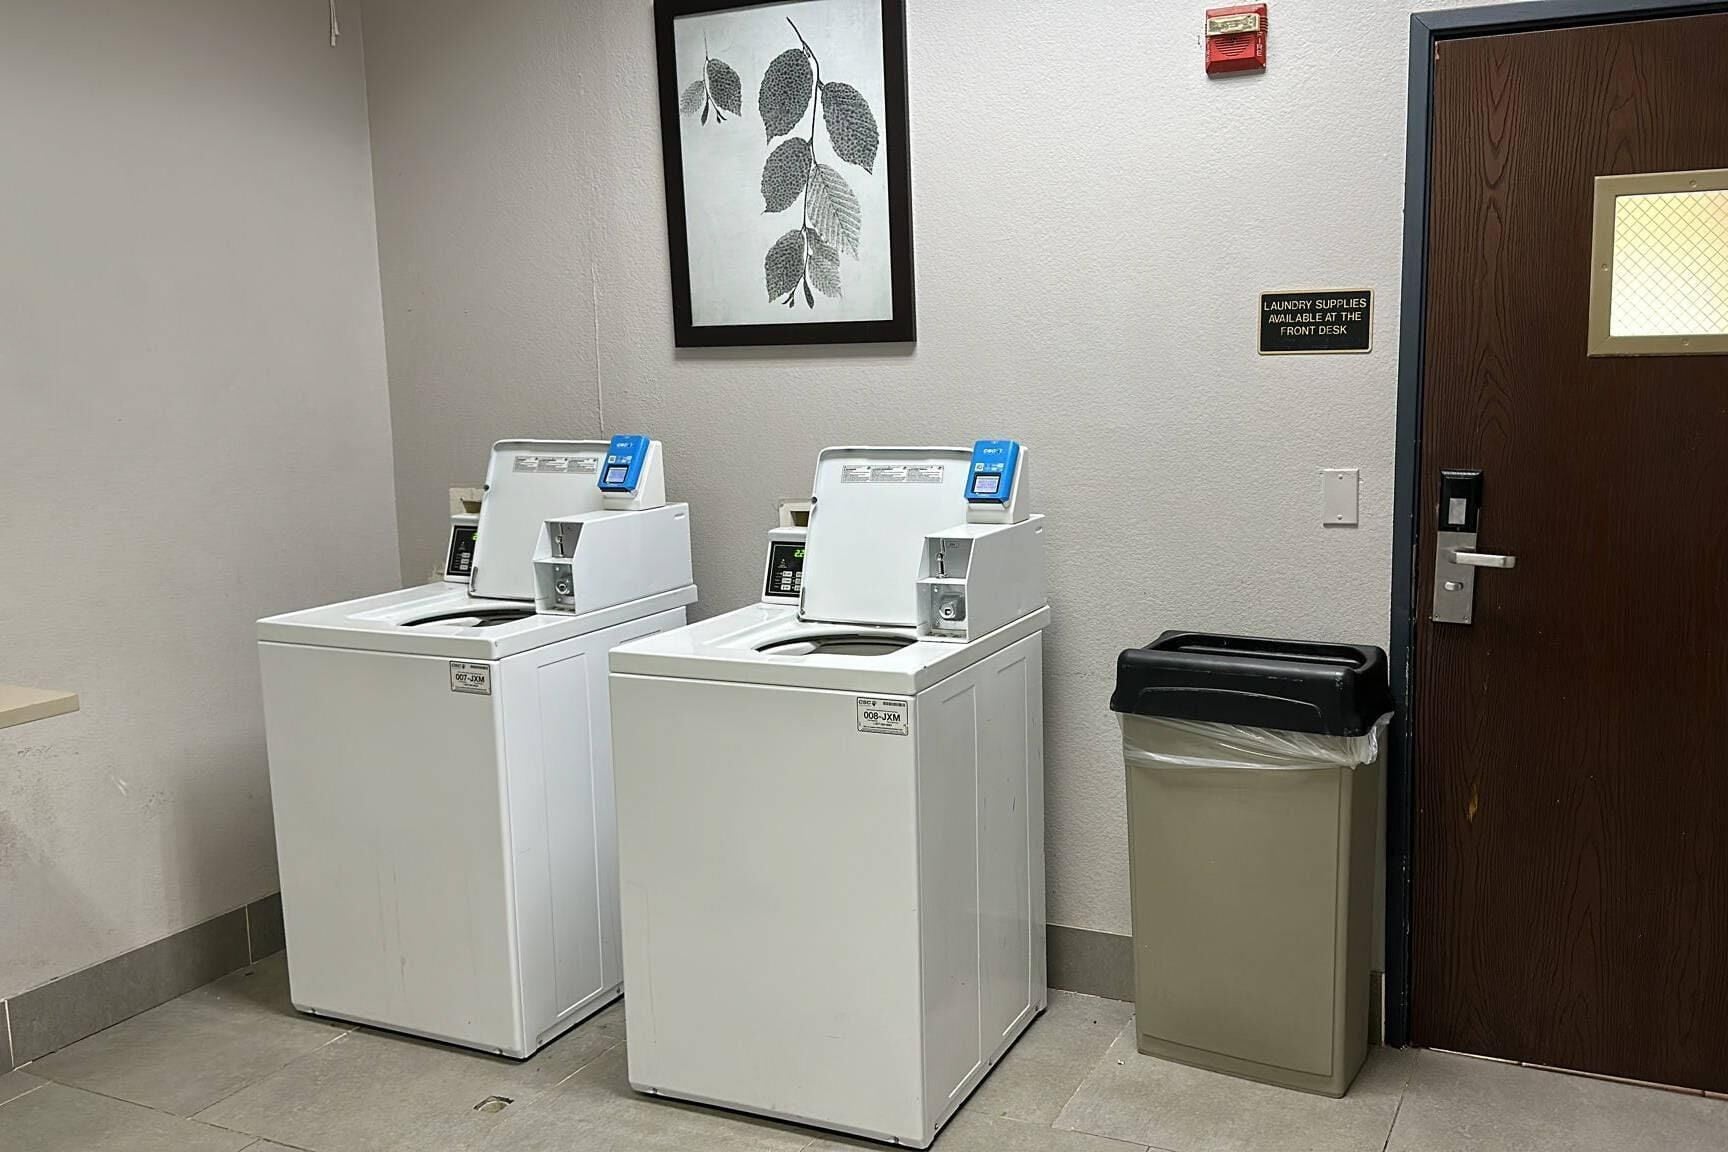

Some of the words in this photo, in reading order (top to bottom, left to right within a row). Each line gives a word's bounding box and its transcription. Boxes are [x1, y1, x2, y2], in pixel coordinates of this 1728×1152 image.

[1263, 300, 1312, 311] LAUNDRY
[1315, 298, 1367, 310] SUPPLIES
[1268, 312, 1322, 324] AVAILABLE
[1324, 312, 1337, 322] AT
[1340, 311, 1362, 321] THE
[1280, 325, 1316, 336] FRONT
[1318, 325, 1348, 335] DESK
[455, 673, 485, 683] 007-JXM
[863, 711, 901, 722] 008-JXM
